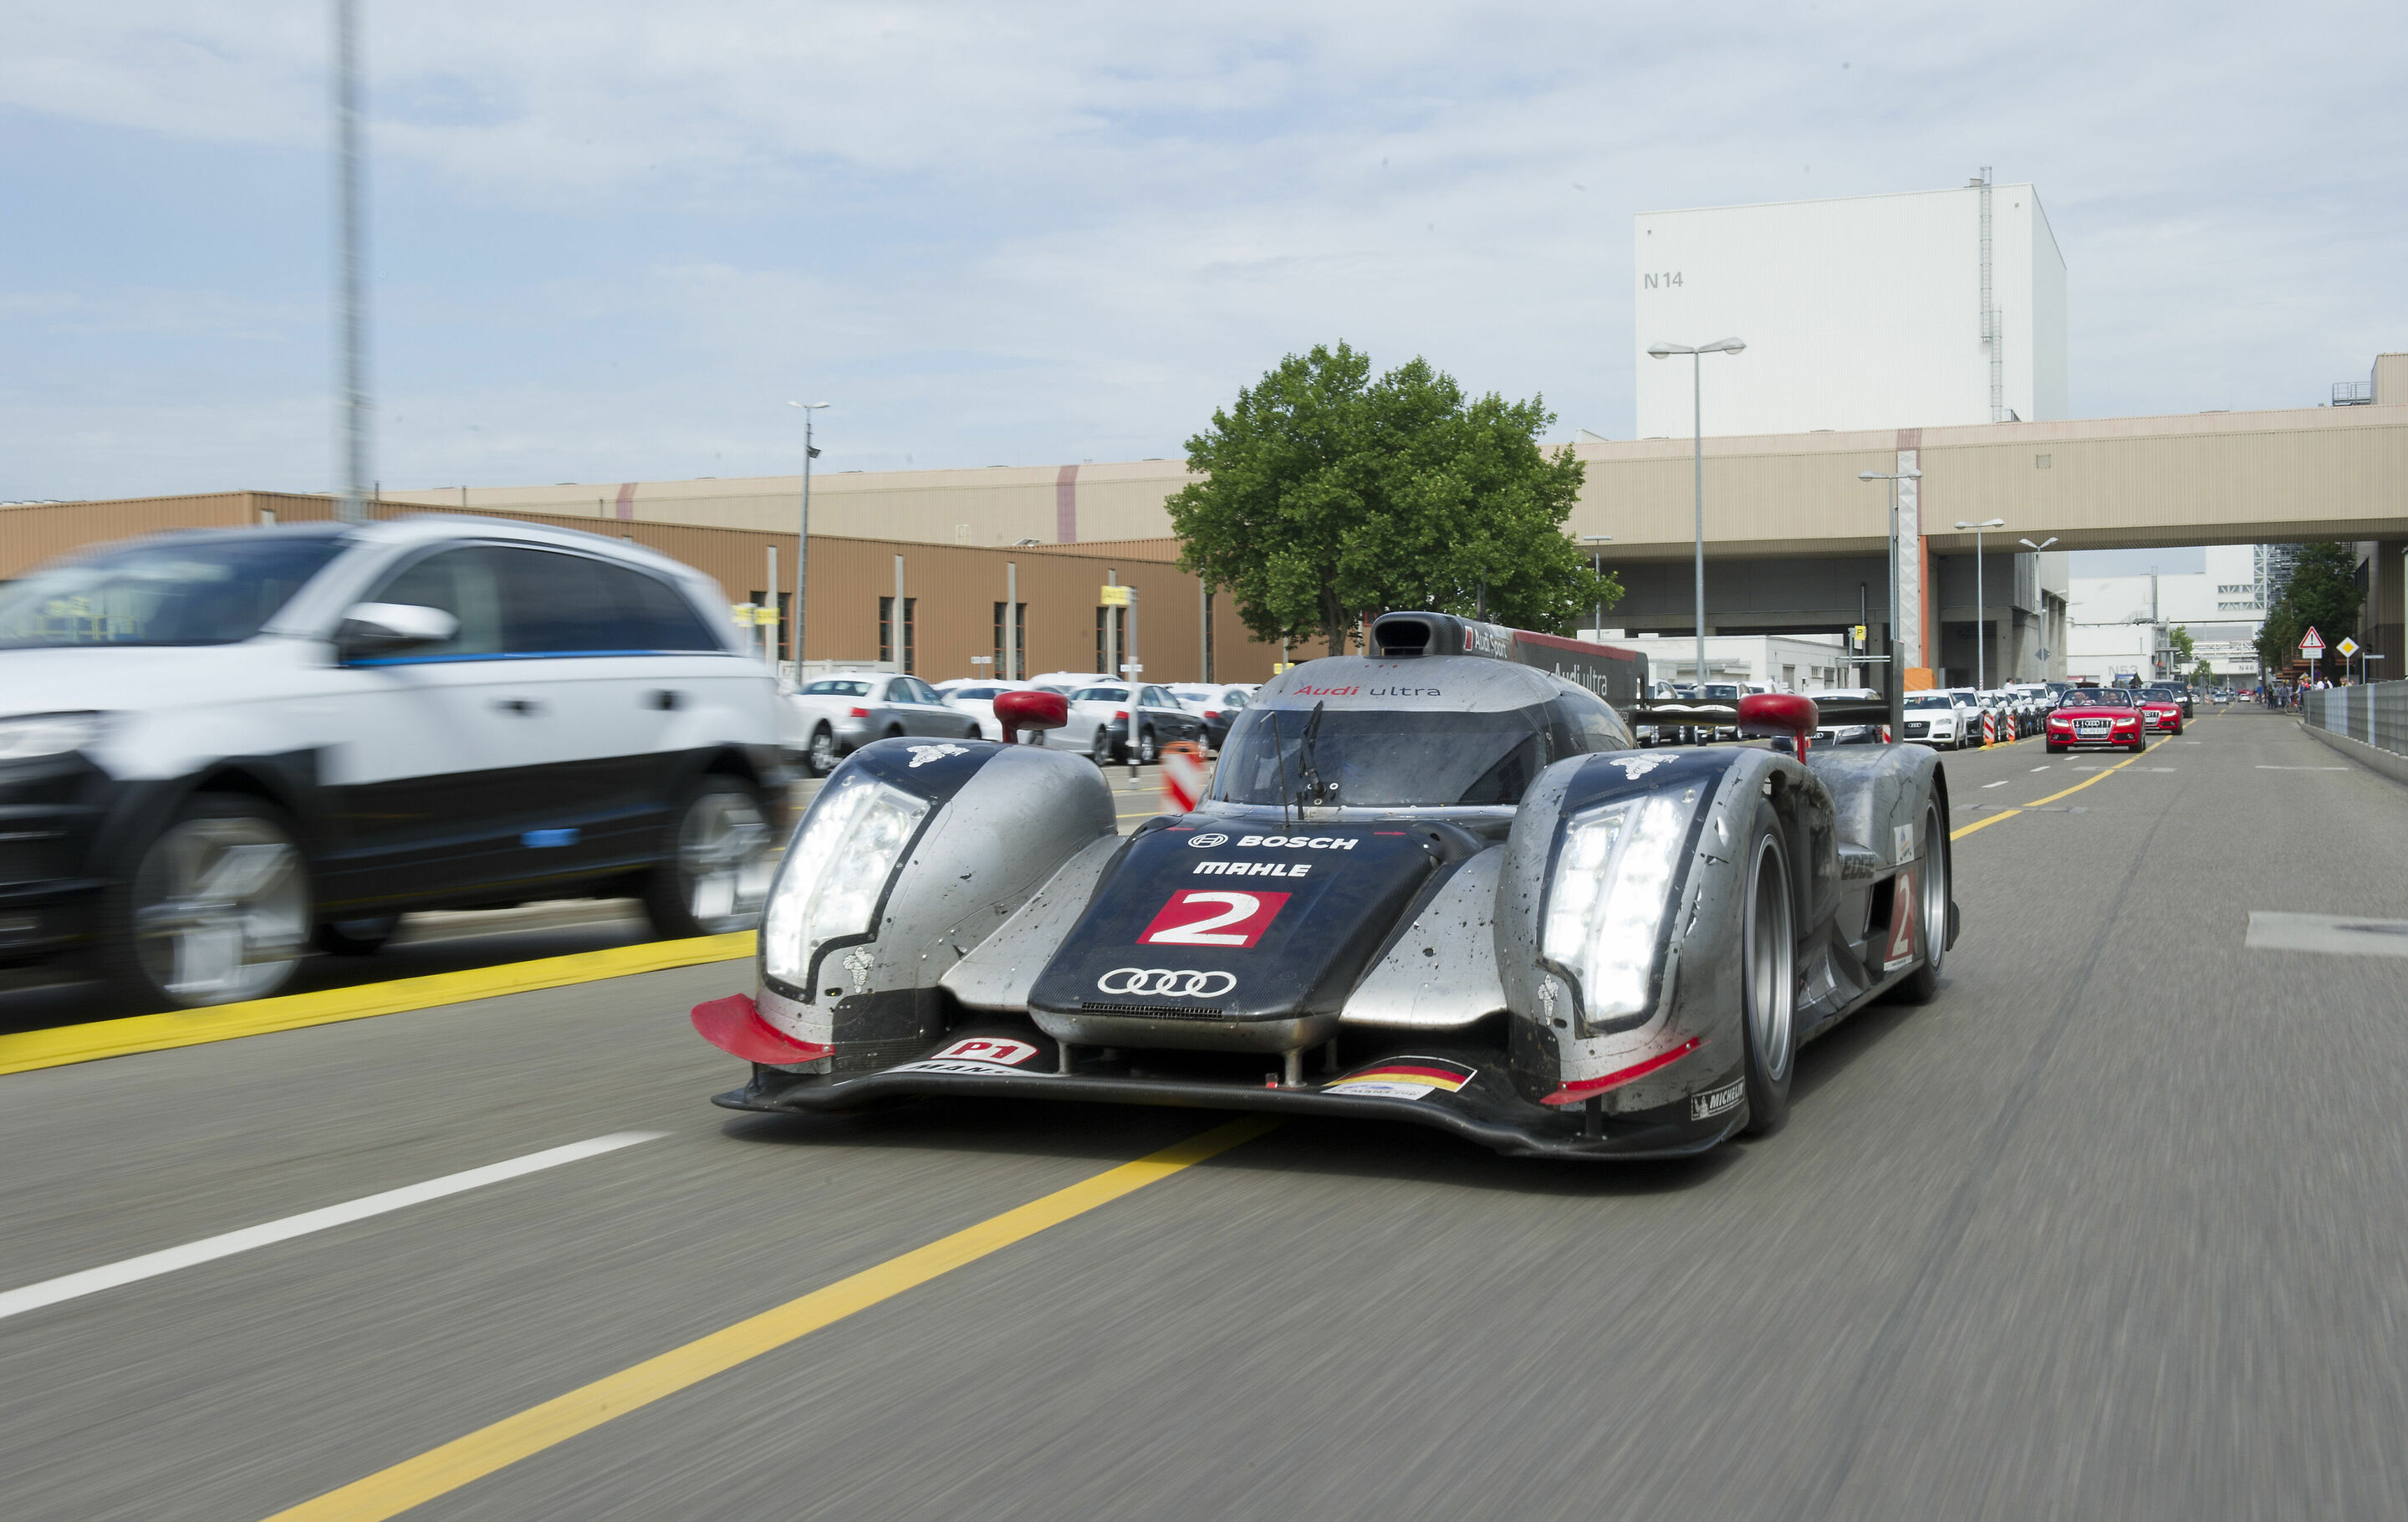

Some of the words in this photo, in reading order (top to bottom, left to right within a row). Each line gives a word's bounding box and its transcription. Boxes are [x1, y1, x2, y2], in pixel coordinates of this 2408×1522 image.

[1645, 273, 1658, 289] N
[1664, 271, 1684, 288] 14
[1474, 628, 1490, 652] Audi
[1490, 634, 1508, 660] Sport
[1293, 685, 1360, 696] Audi
[1370, 686, 1441, 696] ultra
[1237, 835, 1359, 850] BOSCH
[1192, 861, 1313, 877] MAHLE
[1841, 854, 1875, 881] EDGE
[1148, 891, 1260, 946] 2
[1891, 873, 1911, 957] 2
[951, 1042, 1020, 1060] P1
